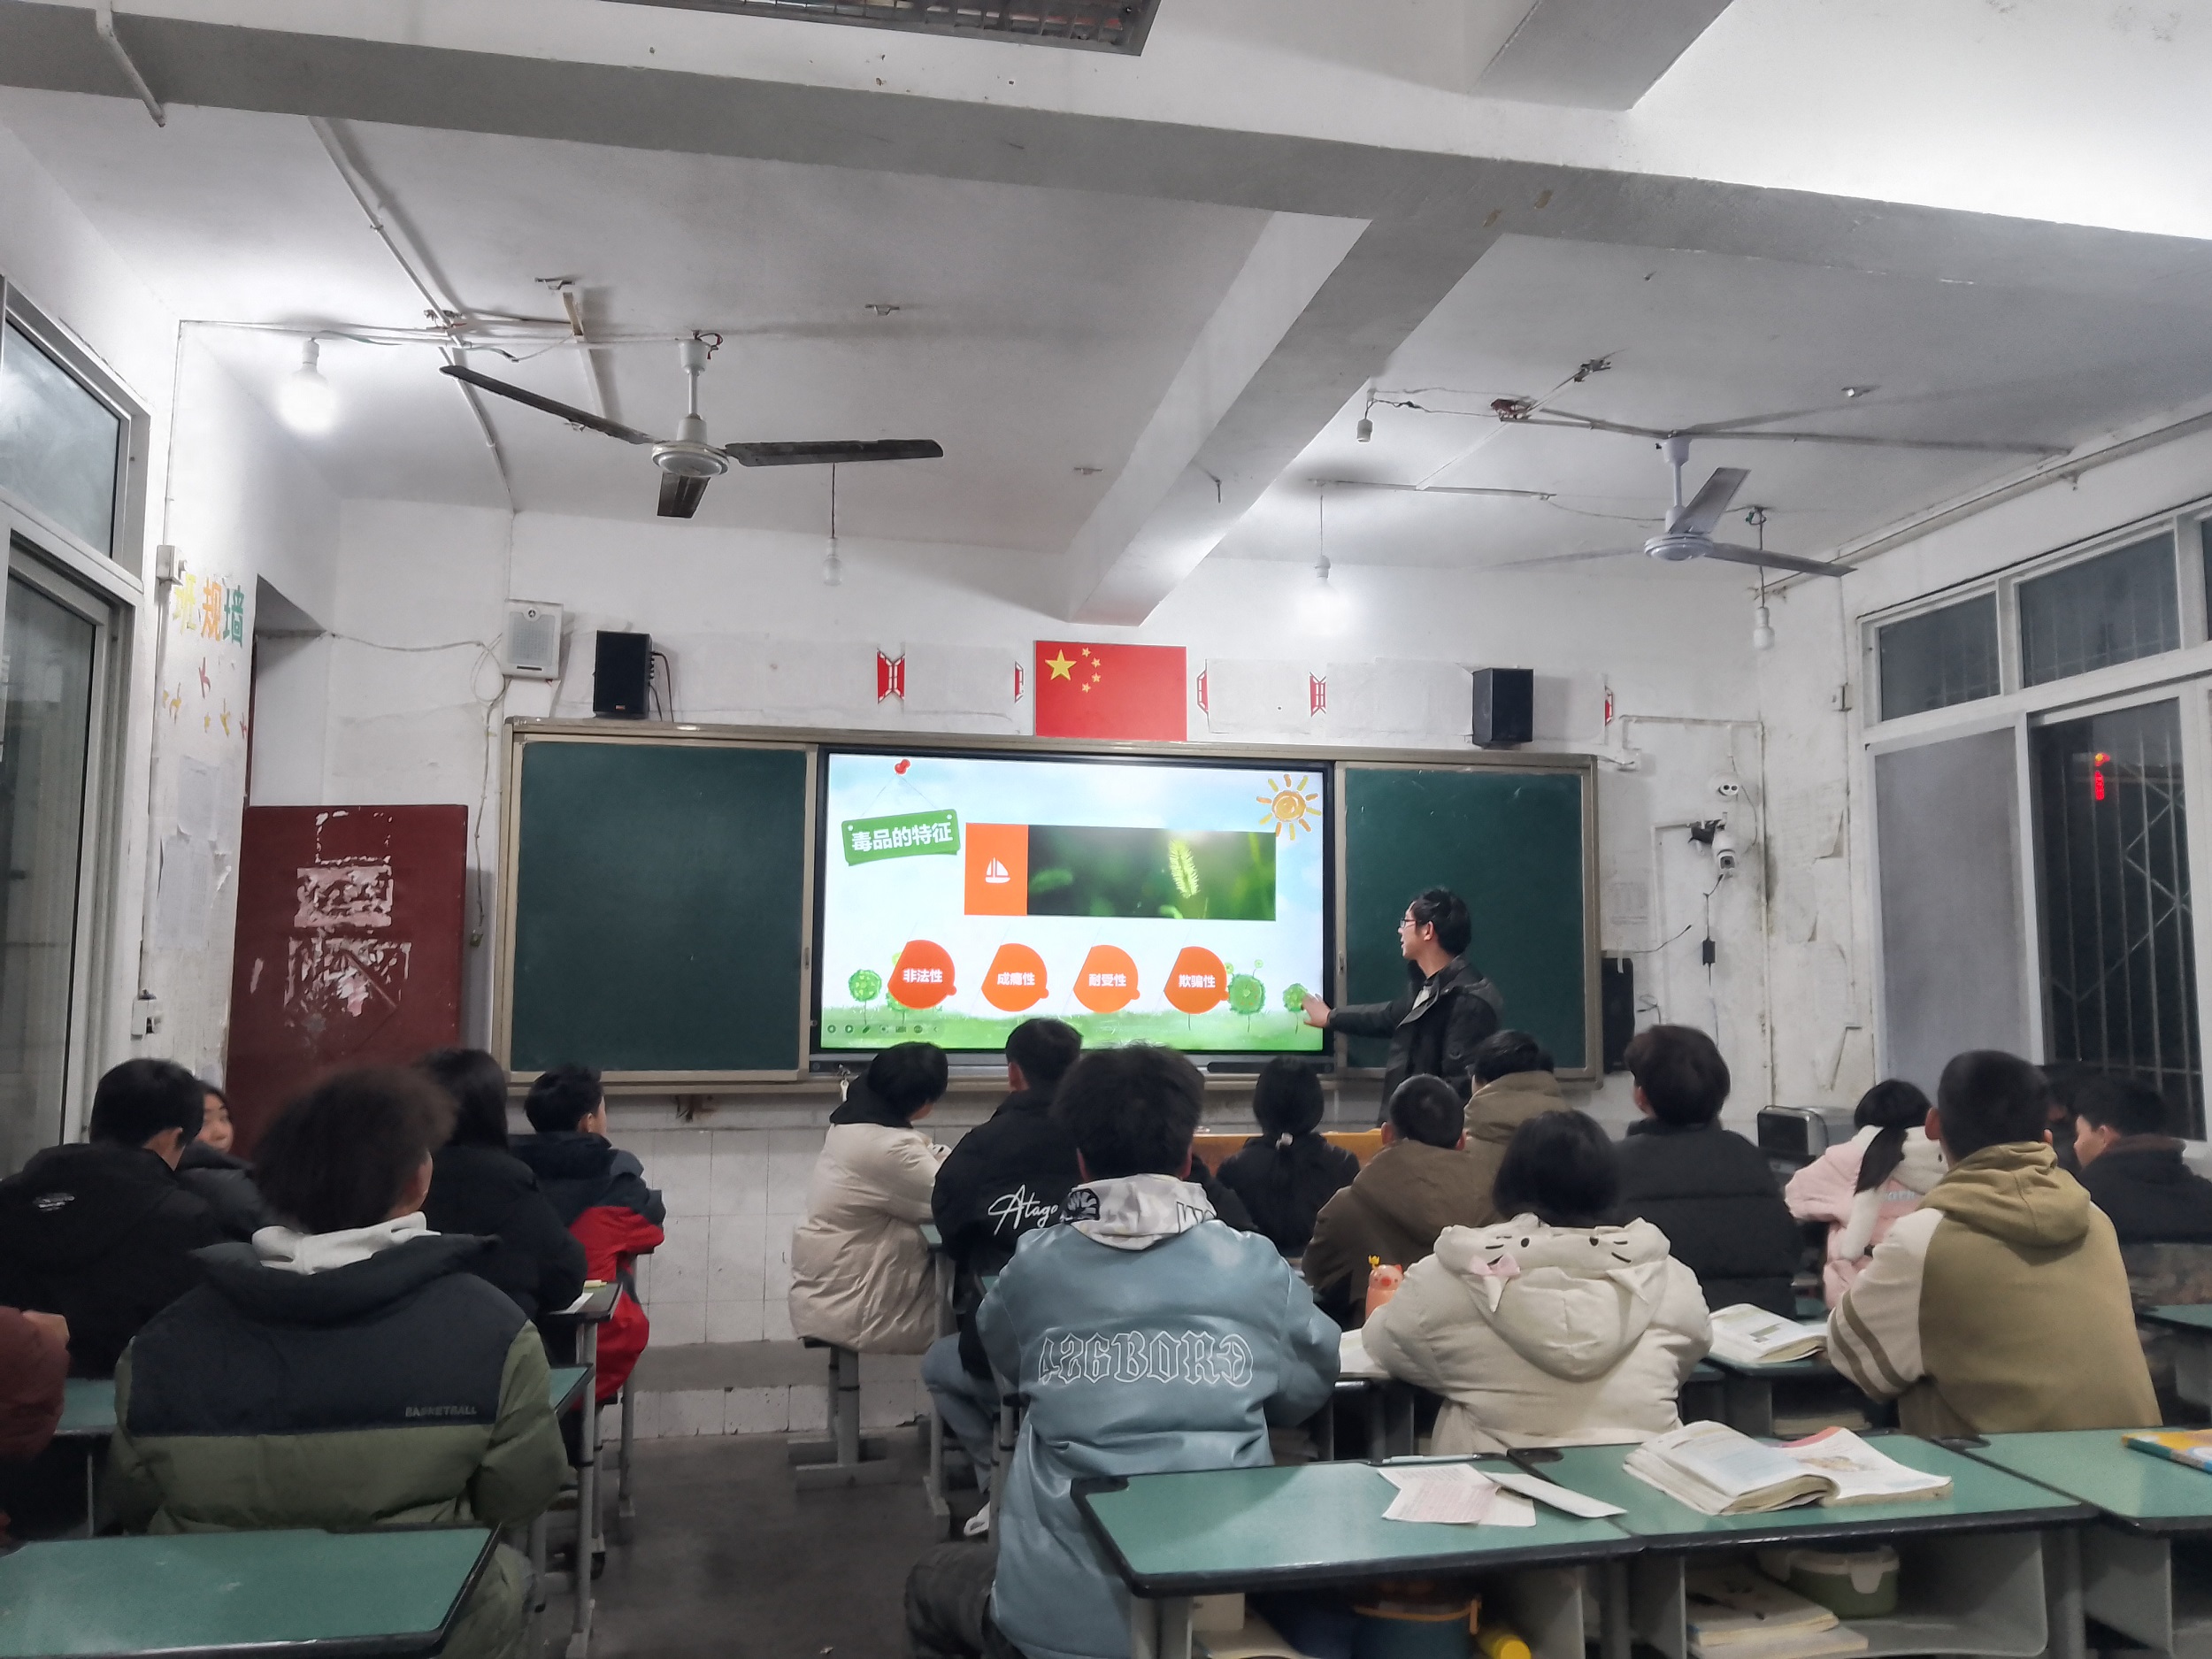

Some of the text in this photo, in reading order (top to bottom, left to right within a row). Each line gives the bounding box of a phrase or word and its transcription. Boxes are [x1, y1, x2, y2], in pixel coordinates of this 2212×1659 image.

[172, 572, 244, 649] 班规墙
[851, 821, 954, 851] 毒品的特征
[902, 968, 943, 984] 非法性
[997, 972, 1036, 986] 成瘾性
[1088, 973, 1126, 987] 耐受性
[1179, 974, 1216, 988] 欺骗性
[987, 1184, 1059, 1235] Atago
[405, 1405, 478, 1417] BASKETBALL
